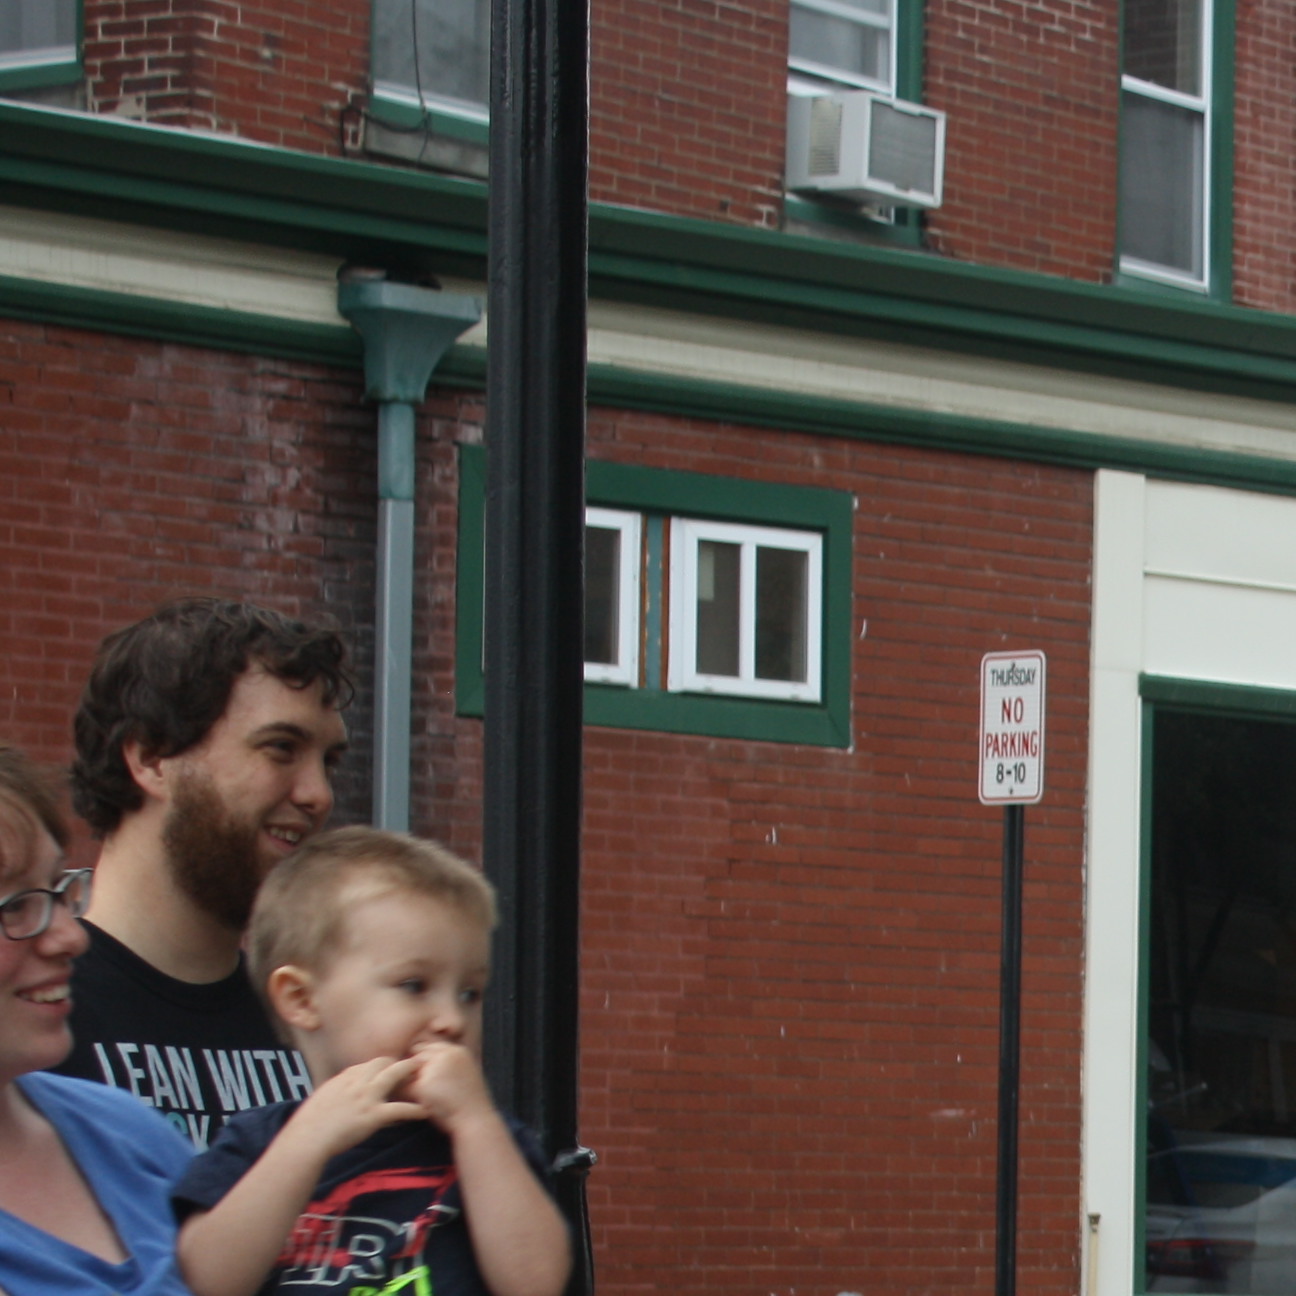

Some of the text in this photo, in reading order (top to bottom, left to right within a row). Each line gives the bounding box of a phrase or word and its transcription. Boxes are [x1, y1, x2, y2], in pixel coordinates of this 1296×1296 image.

[991, 667, 1036, 687] THURSDAY
[1001, 697, 1024, 724] NO
[985, 731, 1038, 758] PARKING
[996, 763, 1026, 783] 8-10
[94, 1042, 313, 1111] LEAN WITH
